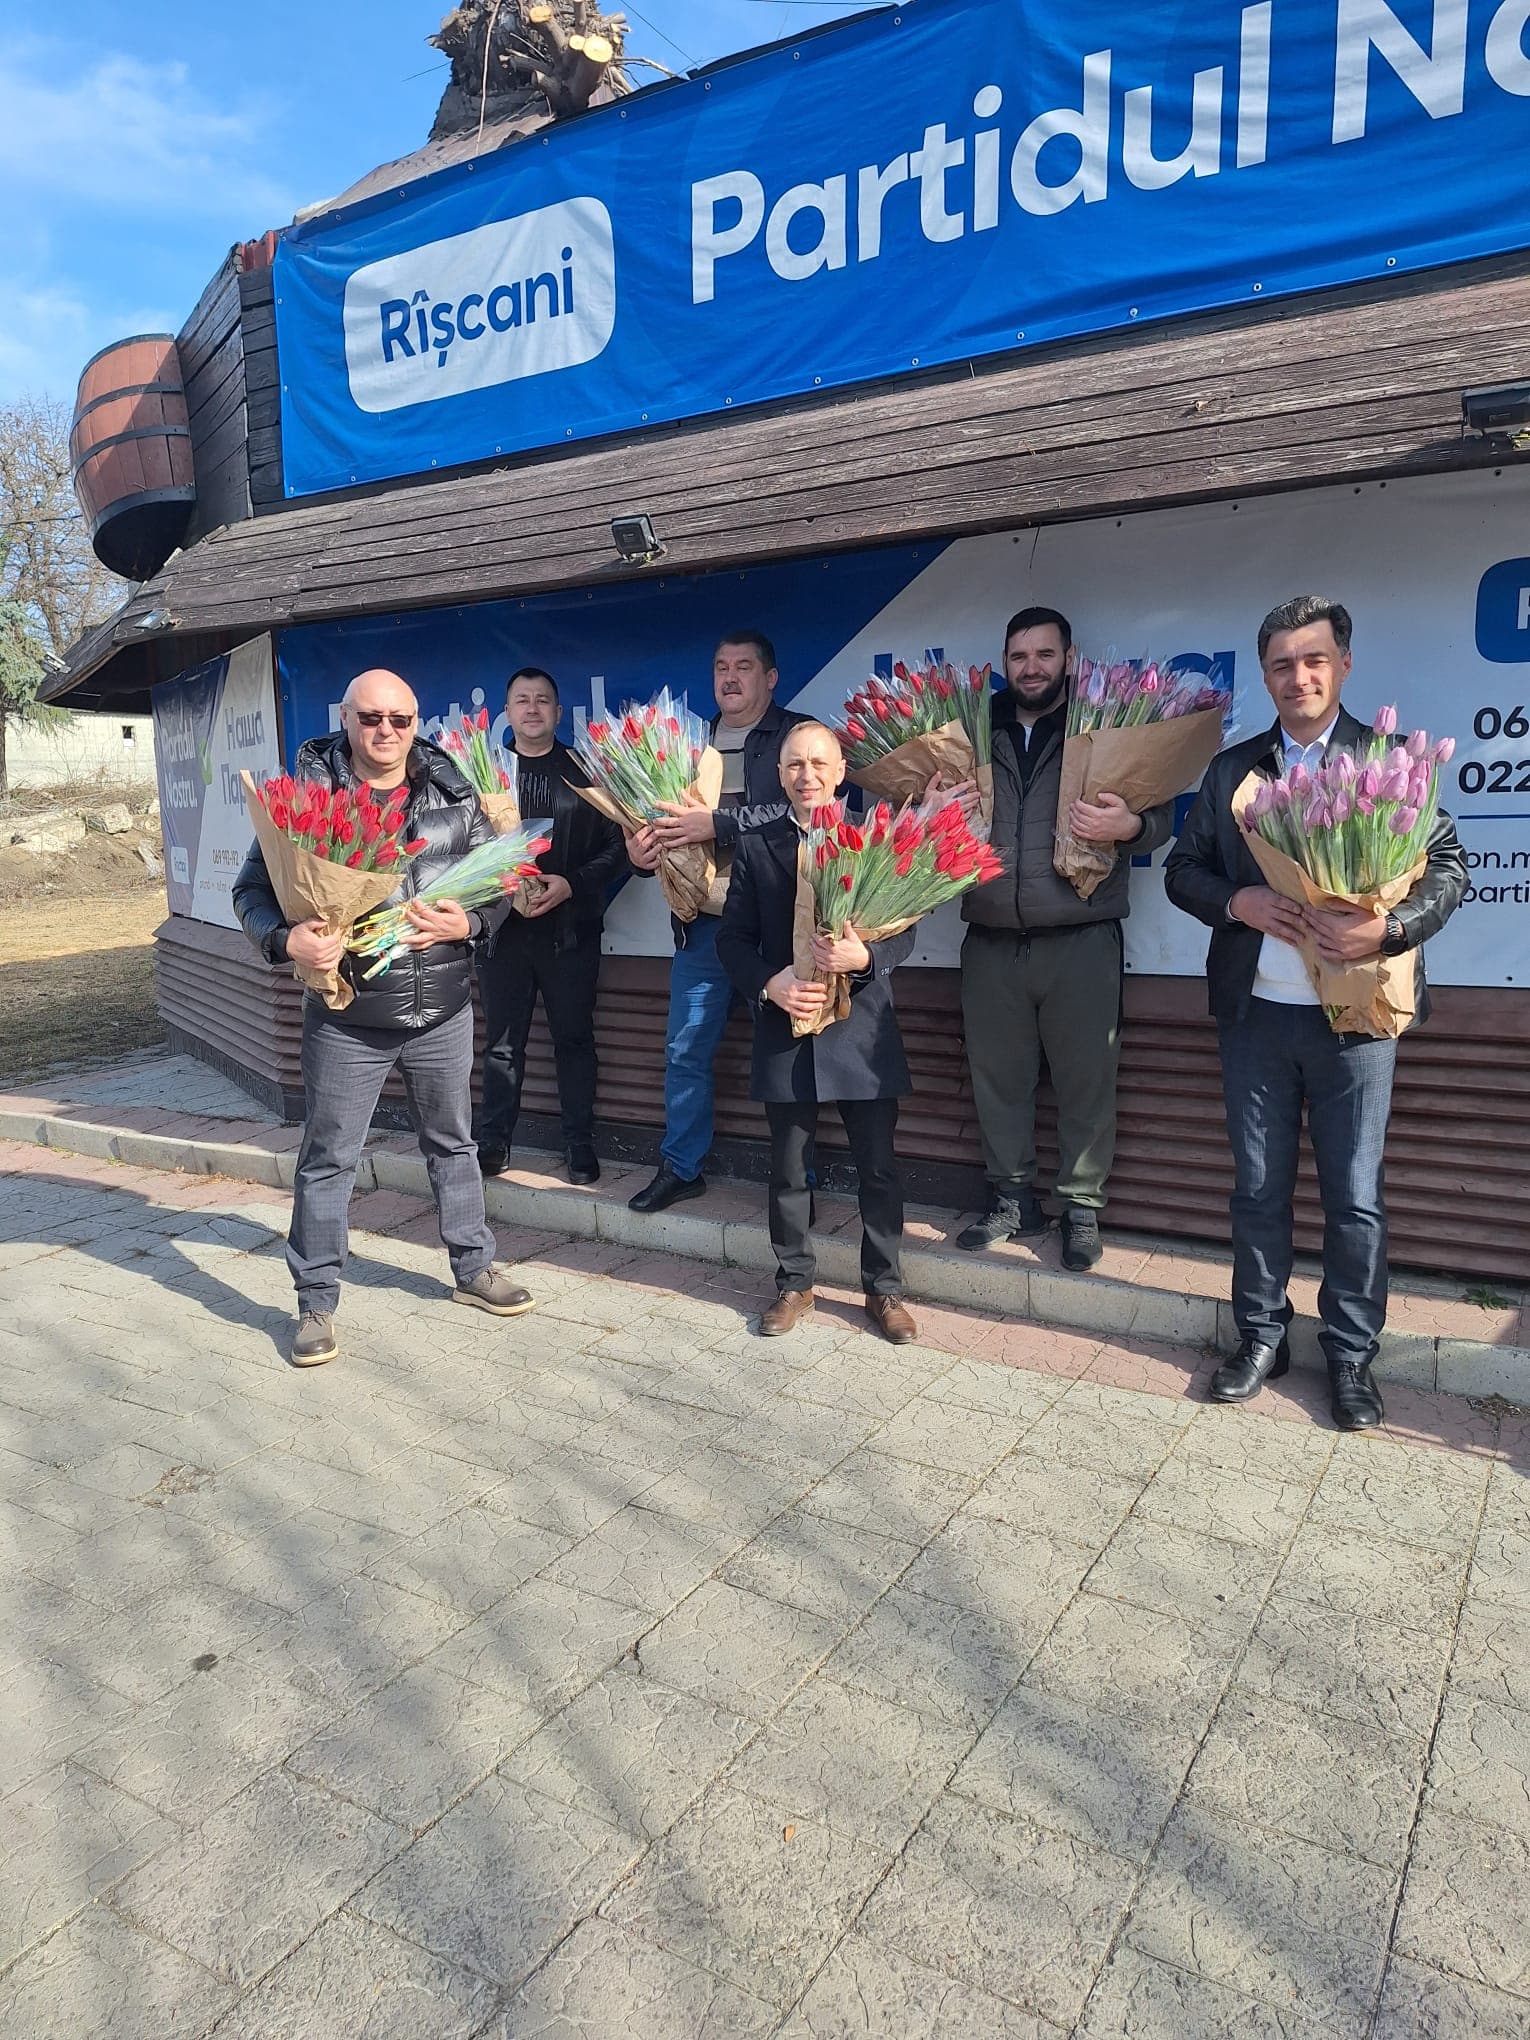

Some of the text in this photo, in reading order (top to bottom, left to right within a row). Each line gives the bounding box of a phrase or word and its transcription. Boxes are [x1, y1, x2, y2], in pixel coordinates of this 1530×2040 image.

[691, 1, 1272, 305] Partidul
[380, 246, 575, 368] Rîșcani
[225, 706, 265, 751] Наша
